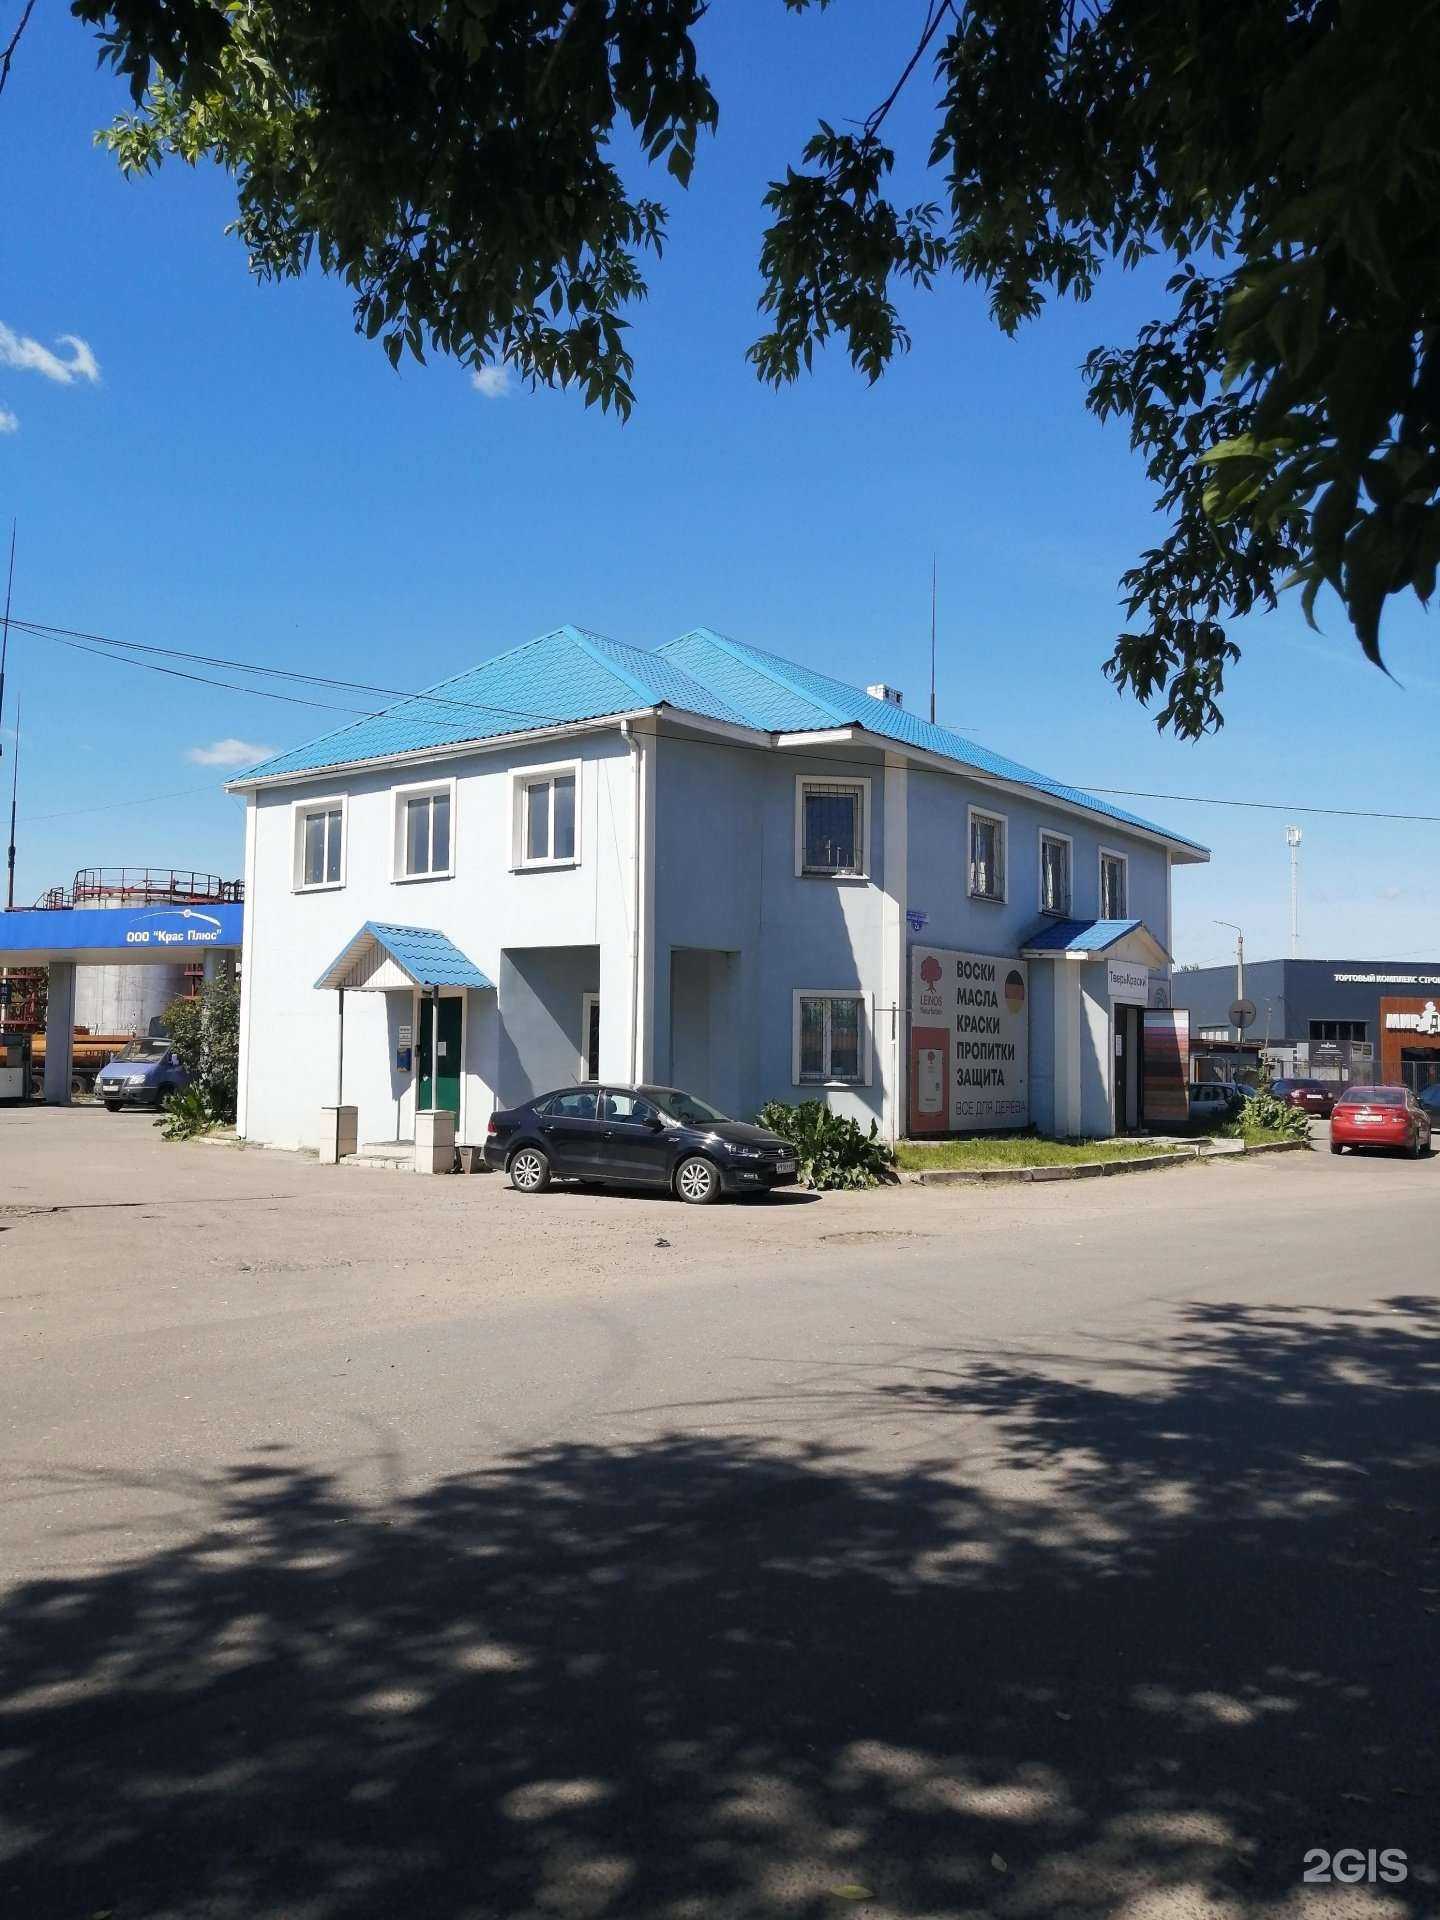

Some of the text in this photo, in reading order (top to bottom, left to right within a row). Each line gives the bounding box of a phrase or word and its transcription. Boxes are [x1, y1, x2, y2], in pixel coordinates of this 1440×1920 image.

[127, 929, 222, 944] ООО "Крас Плюс"
[956, 960, 996, 982] ВОСКИ
[1334, 973, 1376, 983] ТОРГОВЫЙ
[1376, 975, 1418, 984] КОМПЛЕКС
[956, 987, 999, 1009] МАСЛА
[956, 1014, 1000, 1035] КРАСКИ
[956, 1041, 1015, 1061] ПРОПИТКИ
[956, 1068, 1005, 1088] ЗАЩИТА
[955, 1101, 974, 1116] ВСЕ
